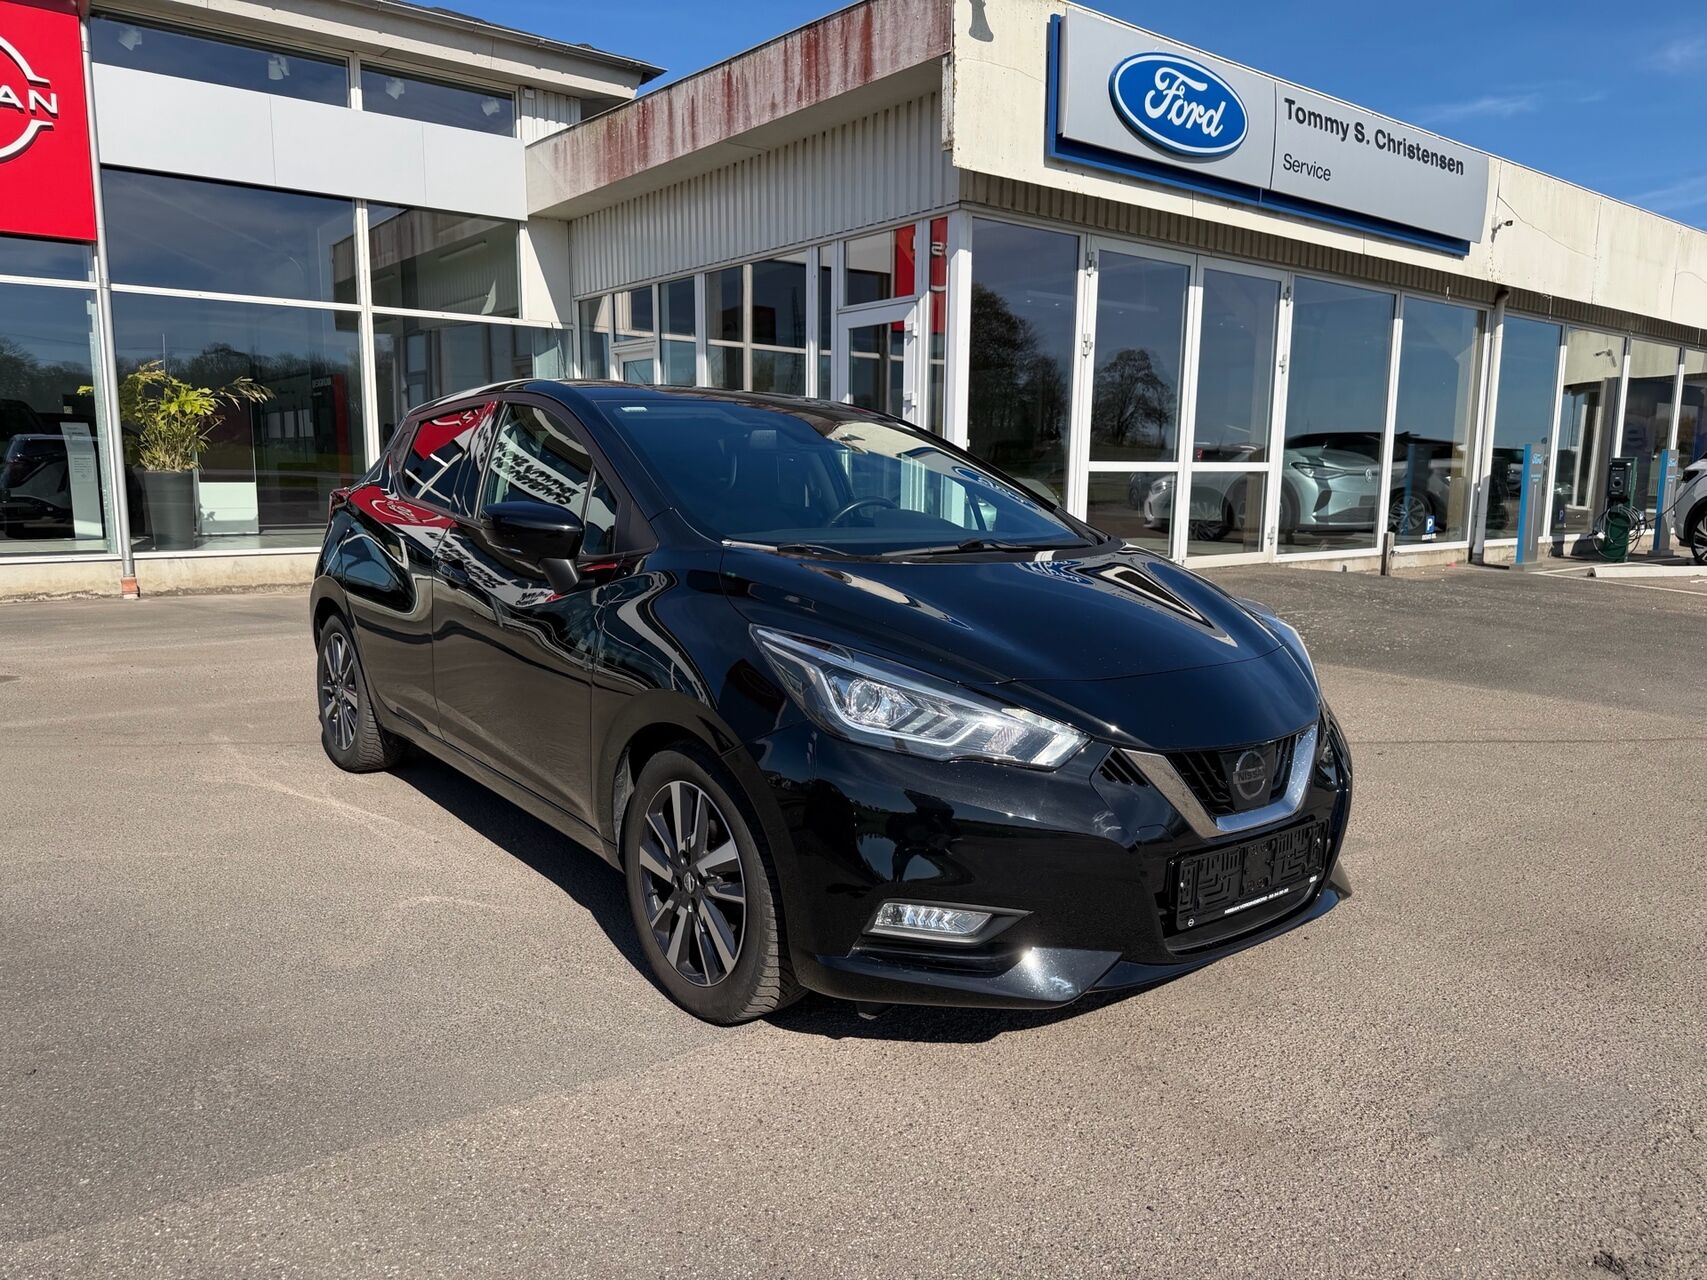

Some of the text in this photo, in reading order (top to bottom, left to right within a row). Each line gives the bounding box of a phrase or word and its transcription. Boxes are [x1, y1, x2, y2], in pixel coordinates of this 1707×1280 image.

[1145, 67, 1226, 137] Ford
[1284, 97, 1465, 176] Tommy S. Christensen
[1283, 153, 1332, 182] Service
